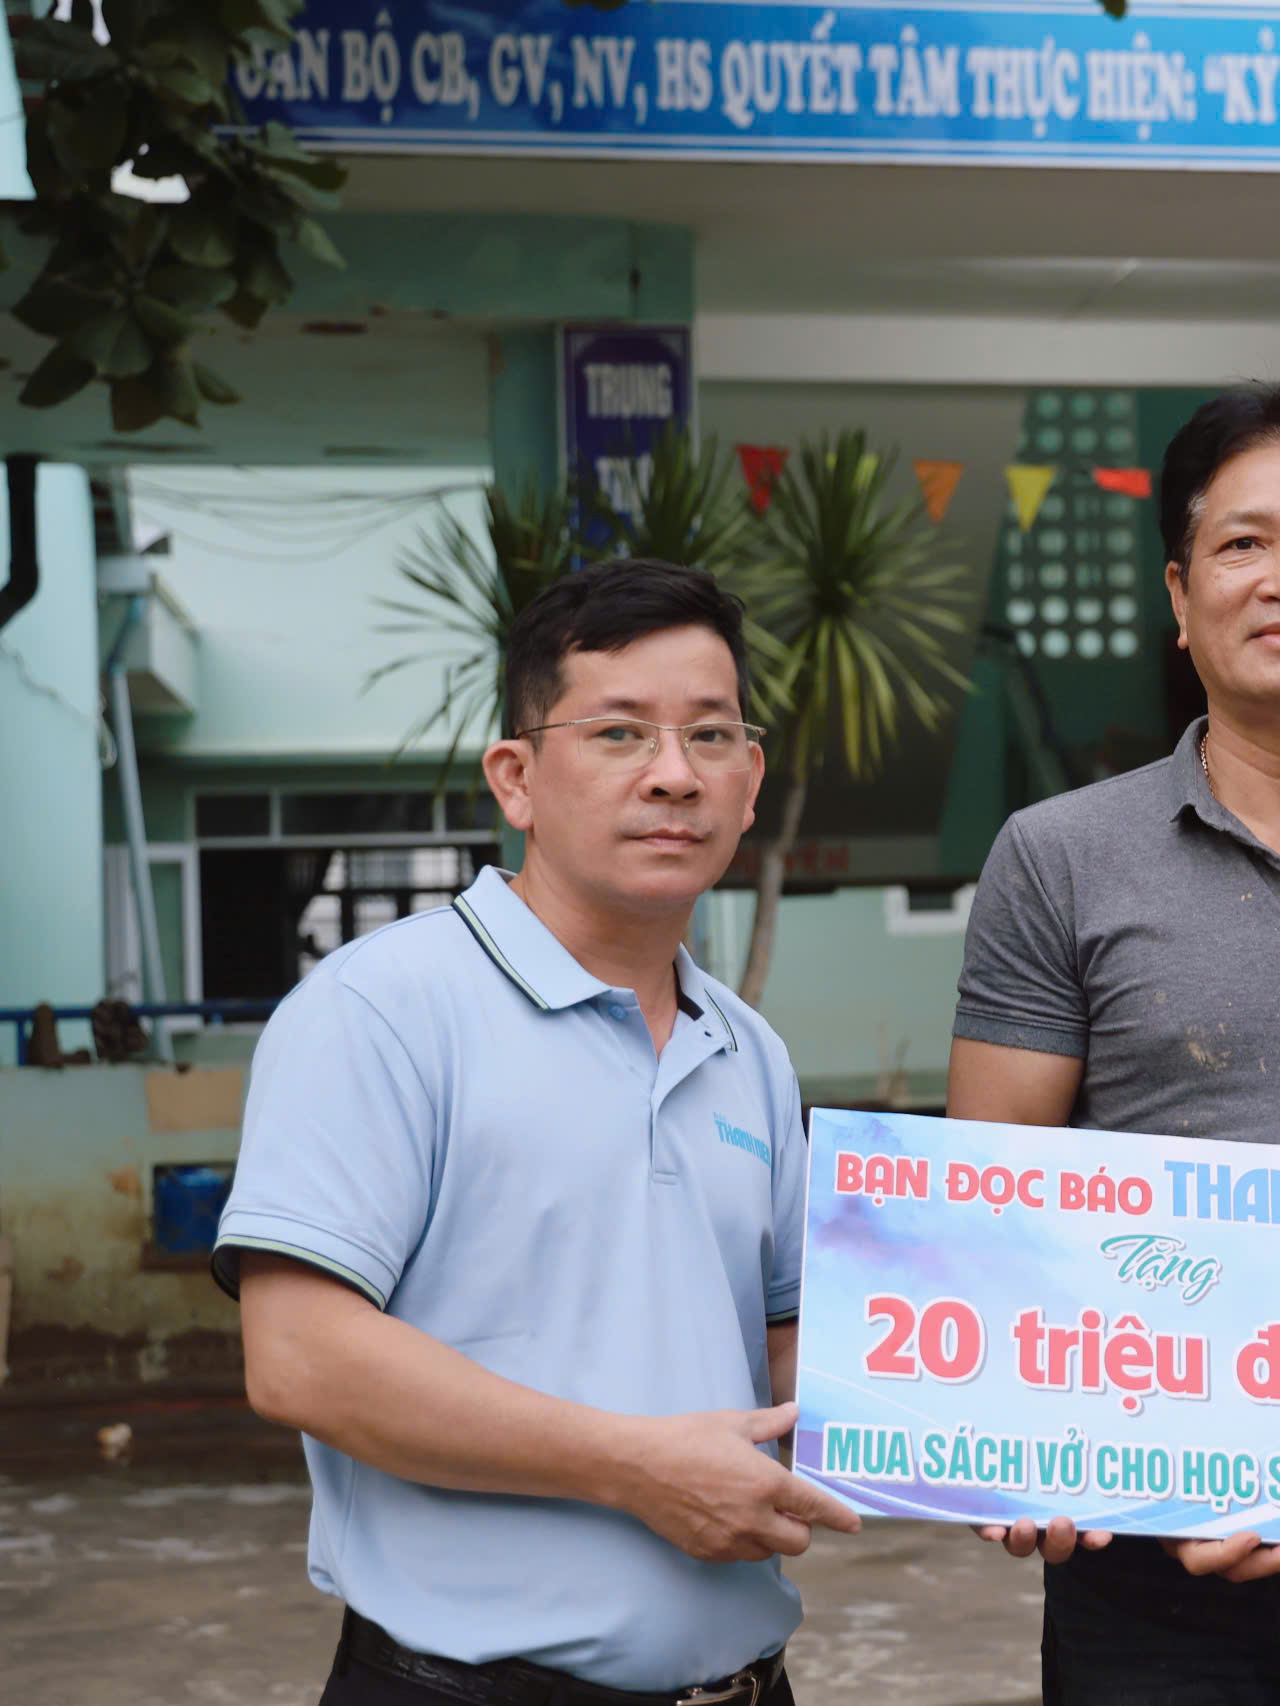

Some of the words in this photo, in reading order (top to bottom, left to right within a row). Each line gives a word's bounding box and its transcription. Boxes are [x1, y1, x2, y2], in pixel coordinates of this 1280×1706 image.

[341, 9, 399, 123] BỘ
[411, 33, 481, 118] CB,
[488, 34, 563, 122] GV,
[571, 36, 648, 125] NV,
[655, 39, 713, 112] HS
[719, 10, 861, 129] QUYẾT
[869, 24, 960, 117] TÂM
[966, 36, 1079, 140] THỰC
[1086, 31, 1197, 141] HIỆN:
[585, 363, 672, 418] TRUNG
[835, 1152, 930, 1204] BẠN
[944, 1161, 1045, 1214] ĐỌC
[1059, 1165, 1154, 1217] BÁO
[1099, 1233, 1220, 1302] Tặng
[865, 1296, 982, 1380] 20
[1012, 1308, 1206, 1413] triệu
[825, 1426, 911, 1478] MUA
[922, 1426, 1025, 1486] SÁCH
[1036, 1428, 1086, 1492] VỞ
[1096, 1447, 1170, 1495] CHO
[1182, 1450, 1257, 1509] HỌC
